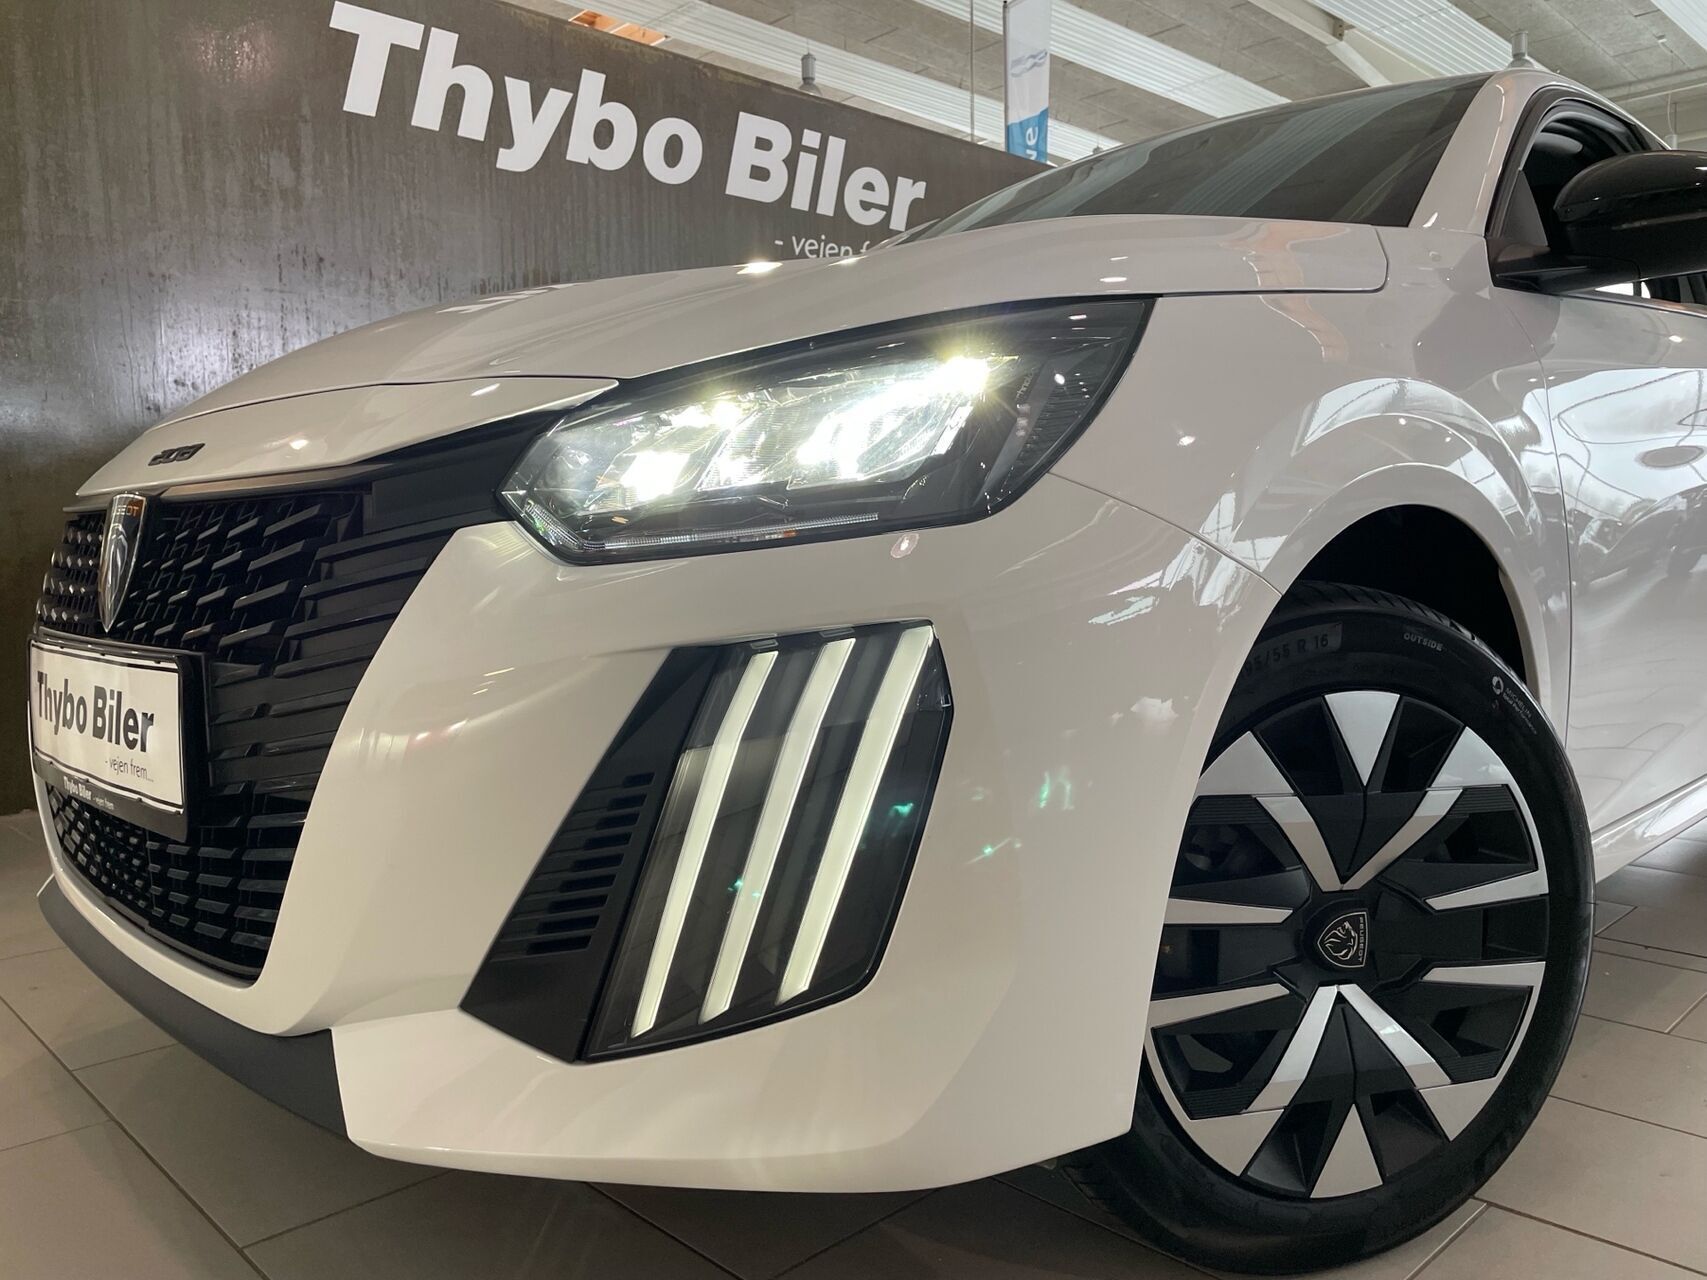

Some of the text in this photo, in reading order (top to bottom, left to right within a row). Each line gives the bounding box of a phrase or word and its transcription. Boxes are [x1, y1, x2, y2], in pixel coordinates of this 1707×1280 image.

[329, 1, 926, 231] Thybo Biler
[1314, 633, 1329, 649] 16
[1403, 632, 1443, 651] OUTSIDE
[37, 670, 154, 753] Thybo Biler
